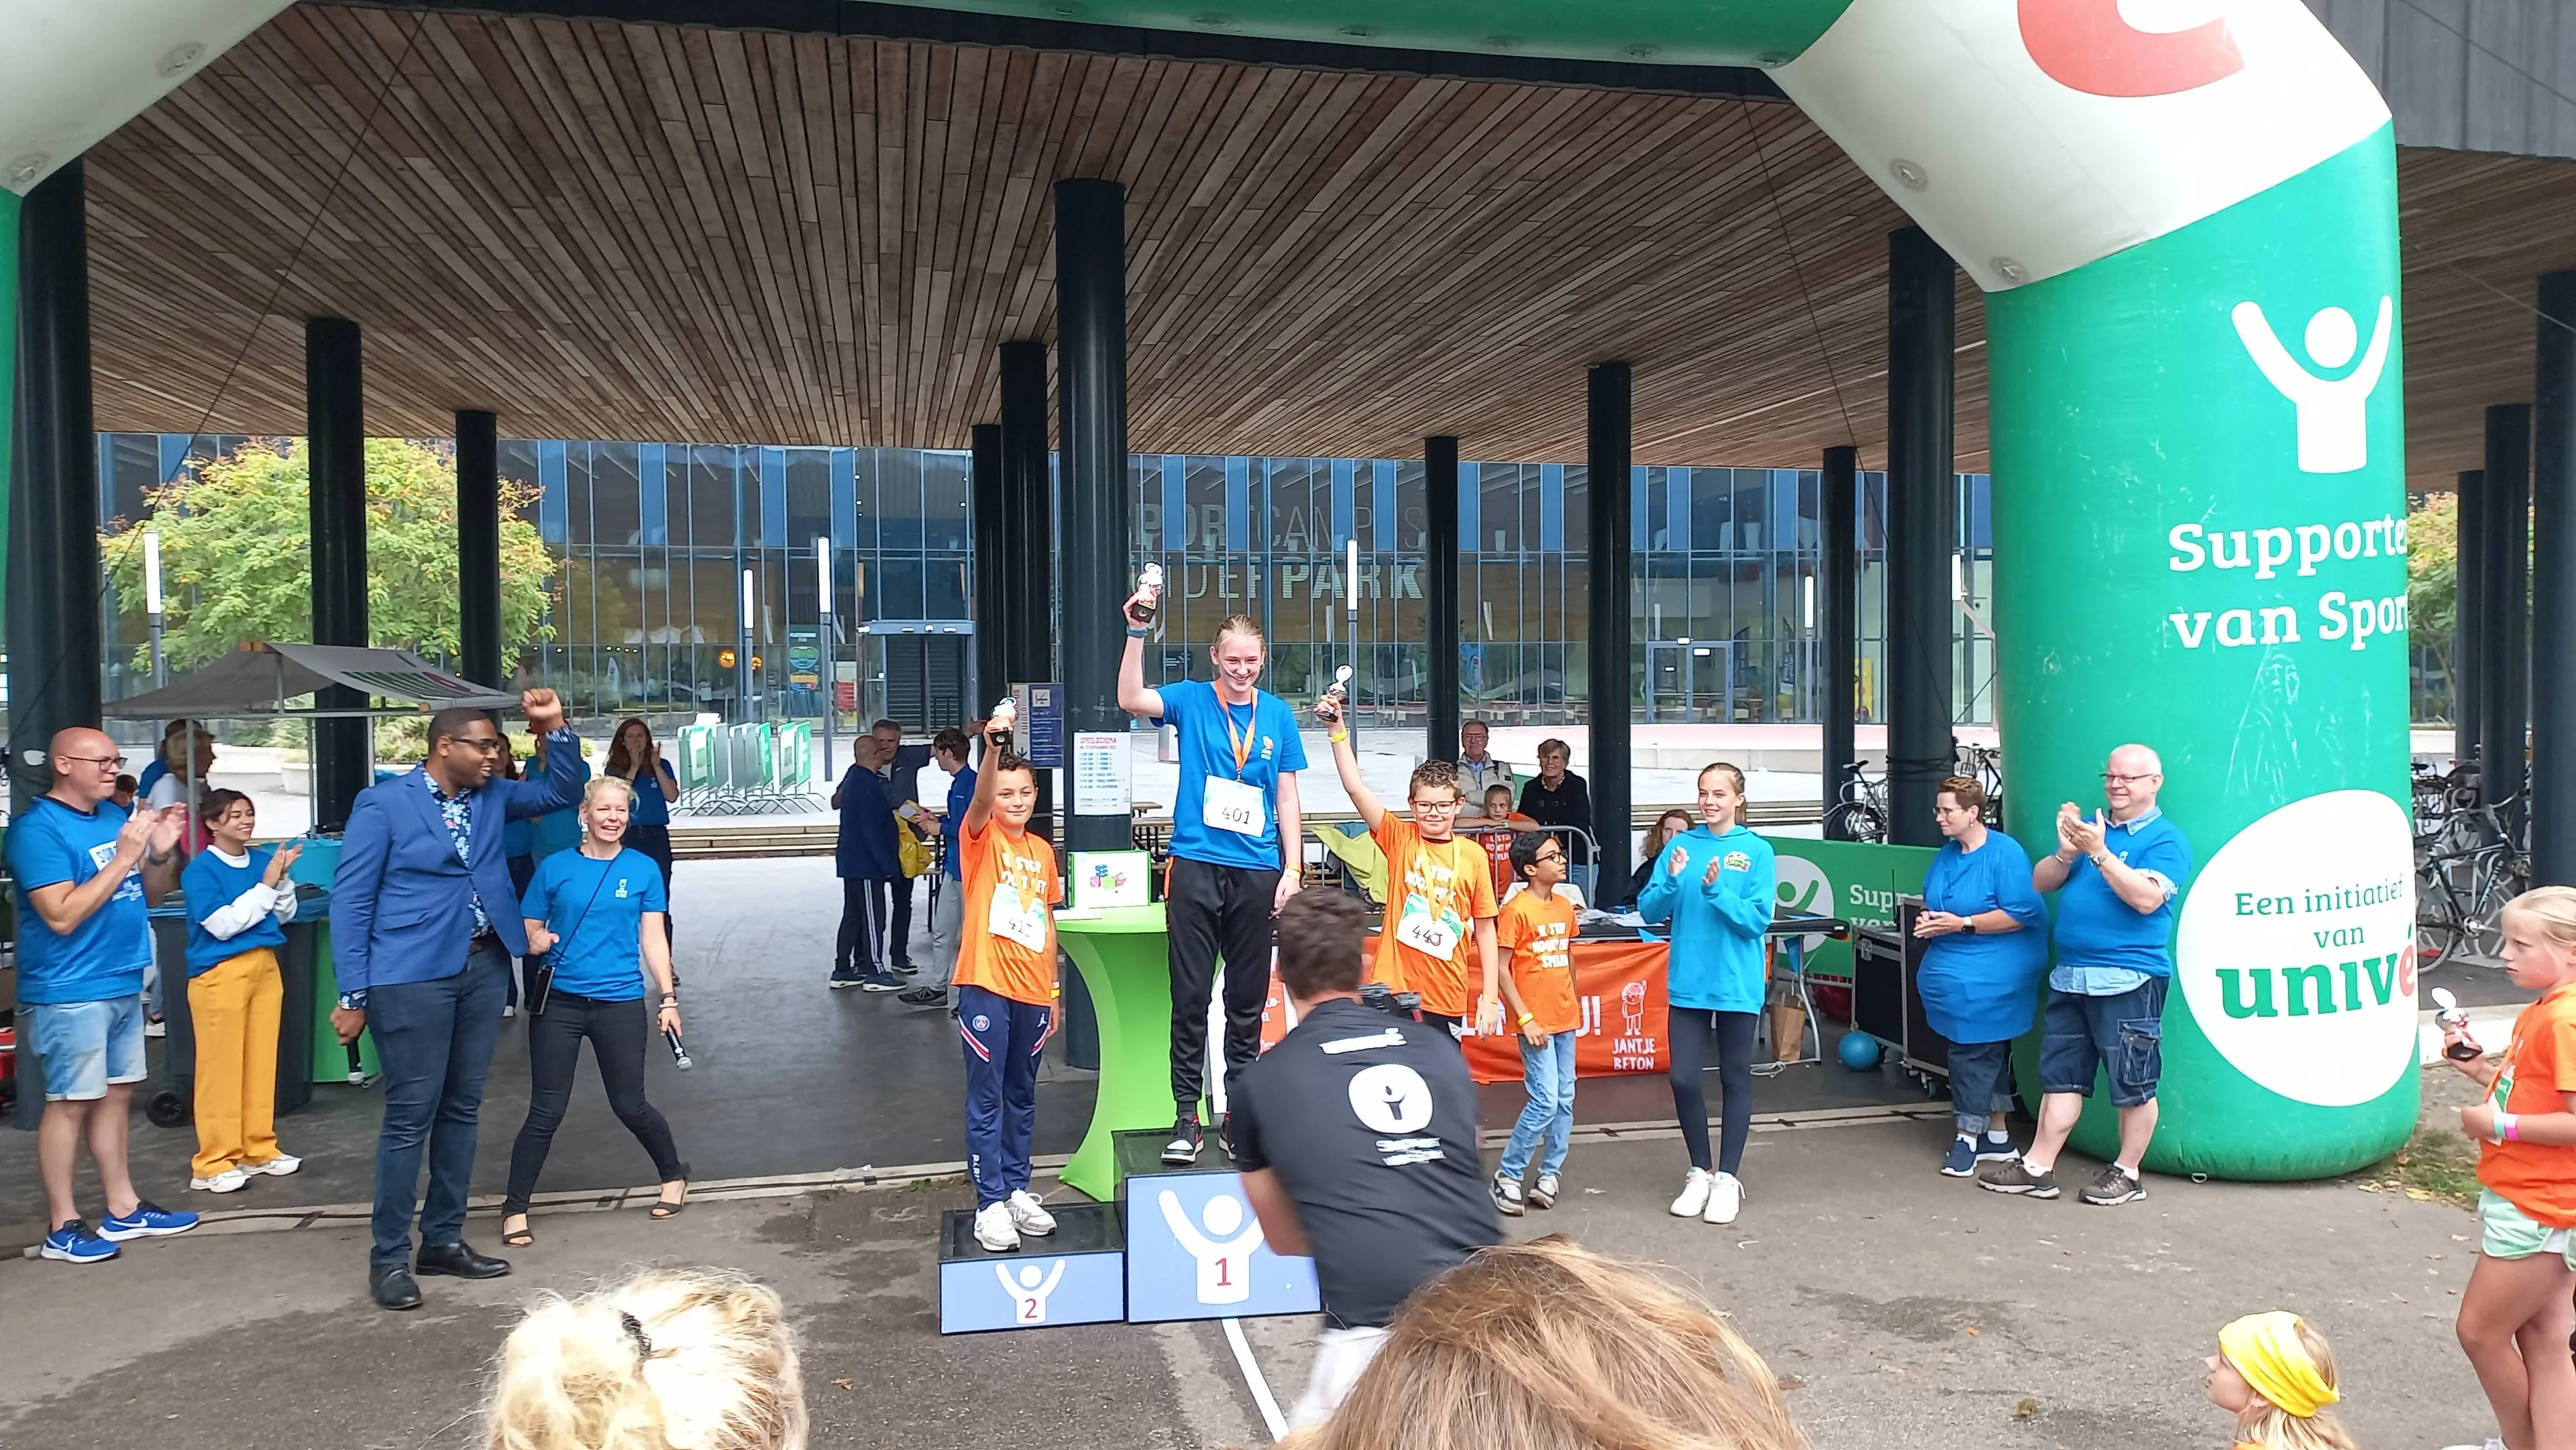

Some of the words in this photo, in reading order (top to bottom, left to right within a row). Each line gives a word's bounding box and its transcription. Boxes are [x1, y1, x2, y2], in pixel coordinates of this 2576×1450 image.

[2168, 513, 2408, 579] Supporte
[2169, 606, 2301, 649] van
[2318, 591, 2409, 651] Spor
[1222, 806, 1250, 825] 401
[2235, 893, 2295, 915] Een
[2304, 873, 2403, 913] initiatief
[2313, 926, 2365, 948] van
[2215, 922, 2415, 1019] univé
[1611, 1038, 1656, 1055] JANTJE
[1613, 1056, 1655, 1071] BETON
[1215, 1258, 1232, 1286] 1
[1024, 1298, 1038, 1319] 2
